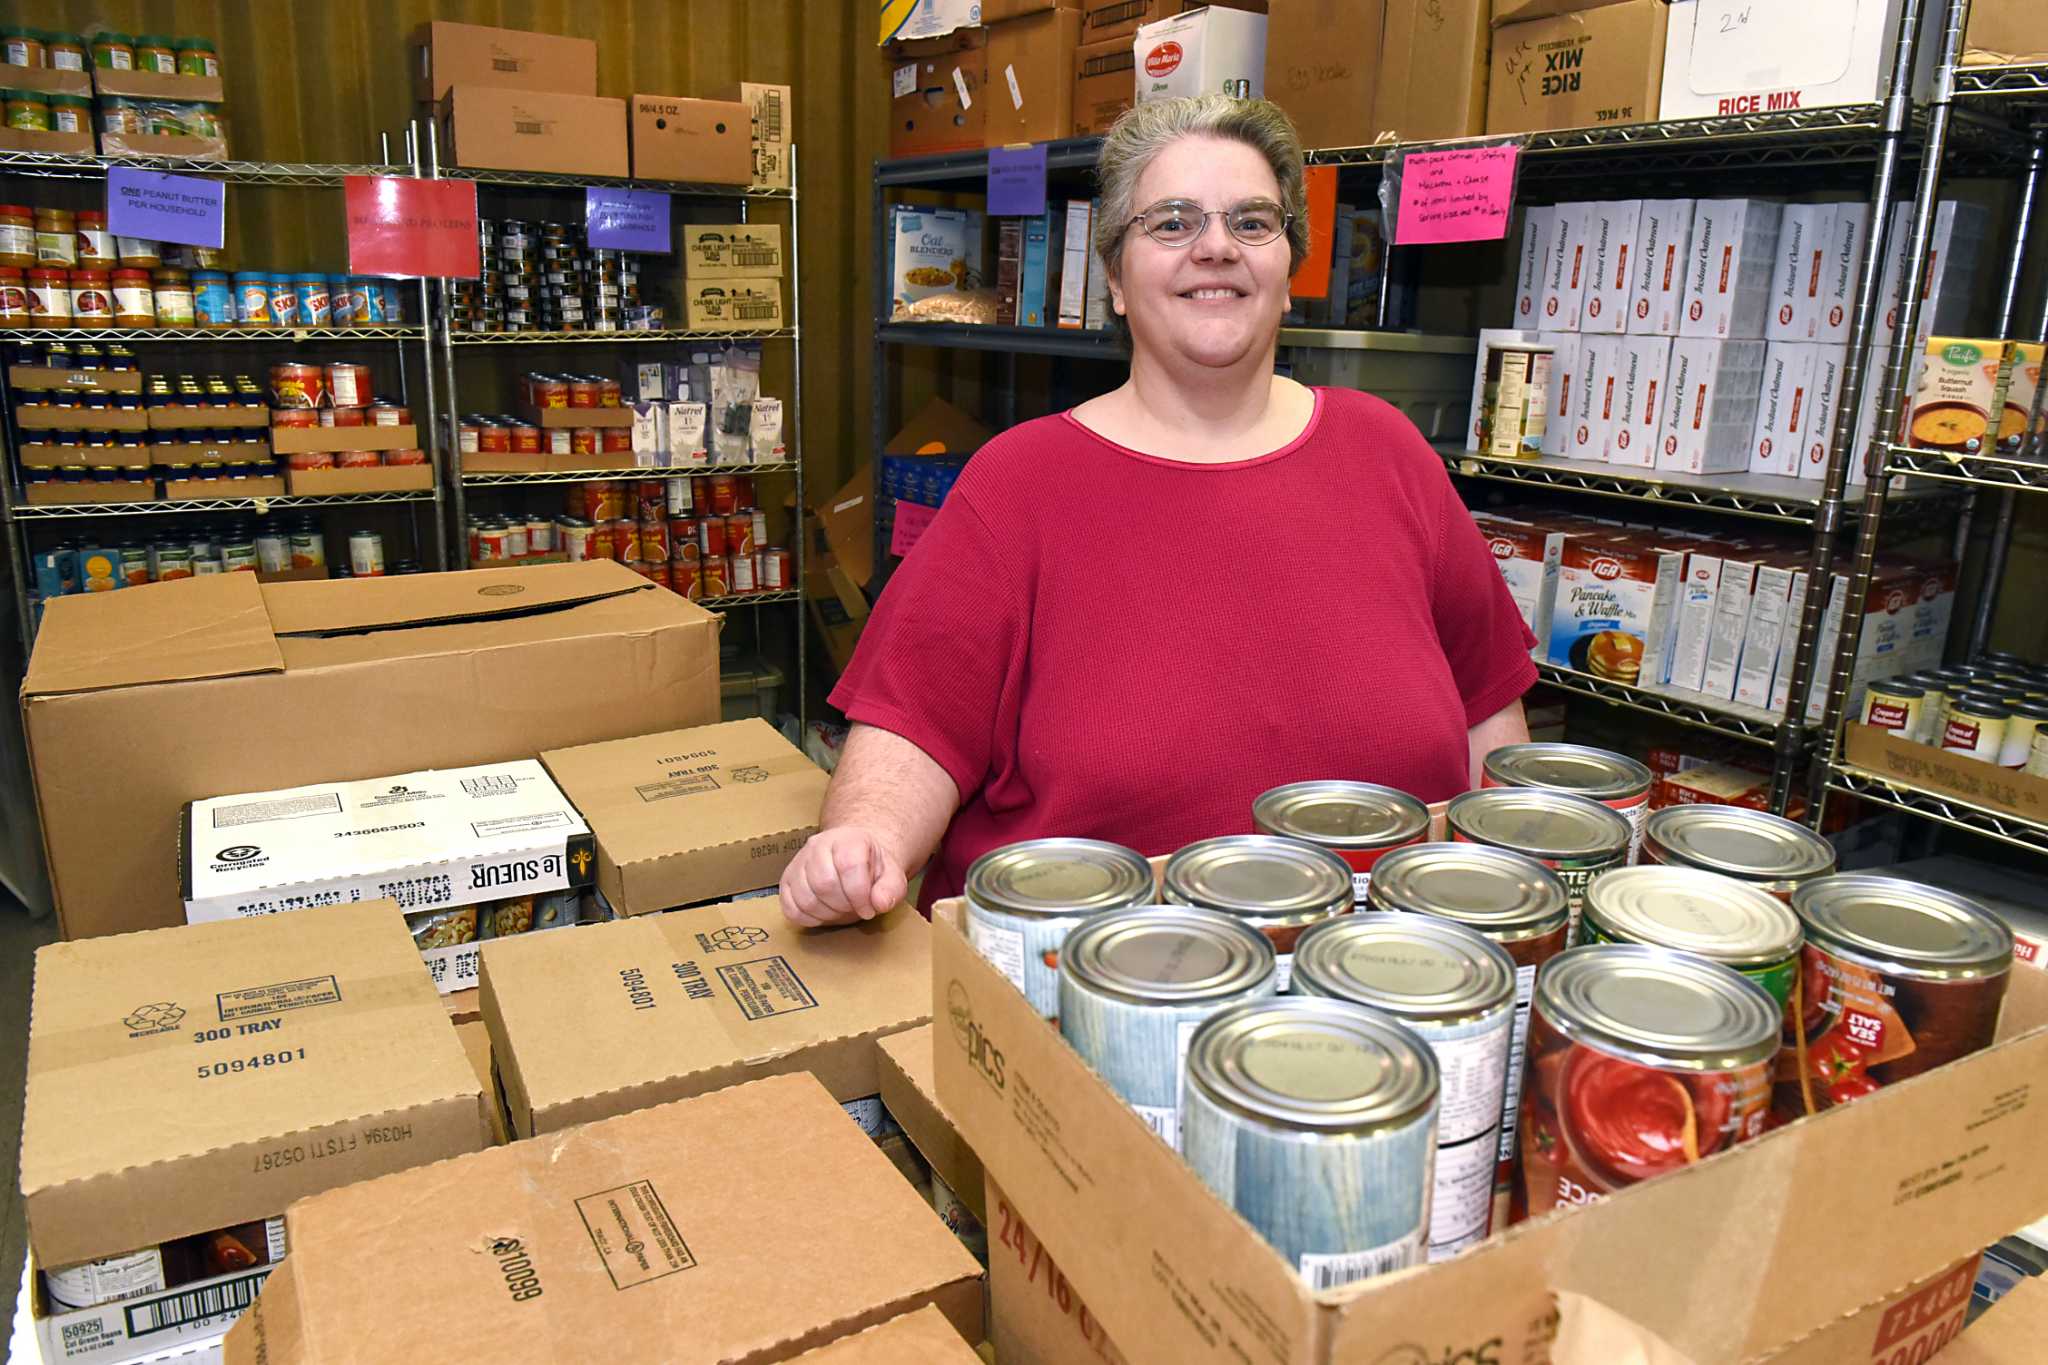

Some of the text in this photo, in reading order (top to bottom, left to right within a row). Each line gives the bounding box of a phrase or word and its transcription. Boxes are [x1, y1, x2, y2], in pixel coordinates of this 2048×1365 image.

[1545, 48, 1584, 72] MIX
[1541, 72, 1581, 96] RICE
[1621, 107, 1633, 118] 36
[1718, 90, 1801, 115] RICE MIX
[120, 186, 217, 207] ONE PEANUT BUTTER
[128, 199, 207, 218] PER HOUSEHOLD
[1551, 218, 1569, 291] Instant Oatmeal
[1593, 217, 1609, 292] Instant Oatmeal
[1641, 216, 1659, 292] Instant Oatmeal
[1694, 217, 1713, 294] Instant Oatmeal
[1784, 221, 1803, 299] Instant Oatmeal
[1835, 220, 1855, 299] Instant Oatmeal
[1946, 346, 1978, 363] Pacific
[1580, 349, 1596, 420] Instant Oatmeal
[1622, 351, 1639, 424] Instant Oatmeal
[1938, 376, 1973, 386] Butternut
[1940, 385, 1967, 394] Squash
[1671, 355, 1689, 430] Instant Oatmeal
[1765, 359, 1785, 433] Instant Oatmeal
[1815, 360, 1836, 438] Instant Oatmeal
[674, 406, 704, 417] Natrel
[754, 401, 780, 413] Natrel
[1491, 542, 1513, 557] IGA
[1593, 561, 1619, 577] IGA
[1570, 586, 1617, 603] Pancake
[1574, 604, 1585, 618] &
[1587, 601, 1624, 617] Waffle
[1874, 706, 1904, 719] Cream of
[668, 768, 695, 779] TRAY
[209, 856, 270, 870] Corrugated
[215, 861, 265, 873] Recycles
[472, 859, 539, 889] SUEUR
[619, 967, 657, 1011] 5094801
[671, 960, 716, 1001] 300 TRAY
[193, 1018, 282, 1044] 300 TRAY
[1848, 1013, 1882, 1032] SALT
[1849, 1025, 1877, 1042] SEA
[197, 1047, 306, 1079] 5094801
[62, 1321, 102, 1338] 50925
[65, 1339, 78, 1350] Cut
[79, 1333, 100, 1346] Green
